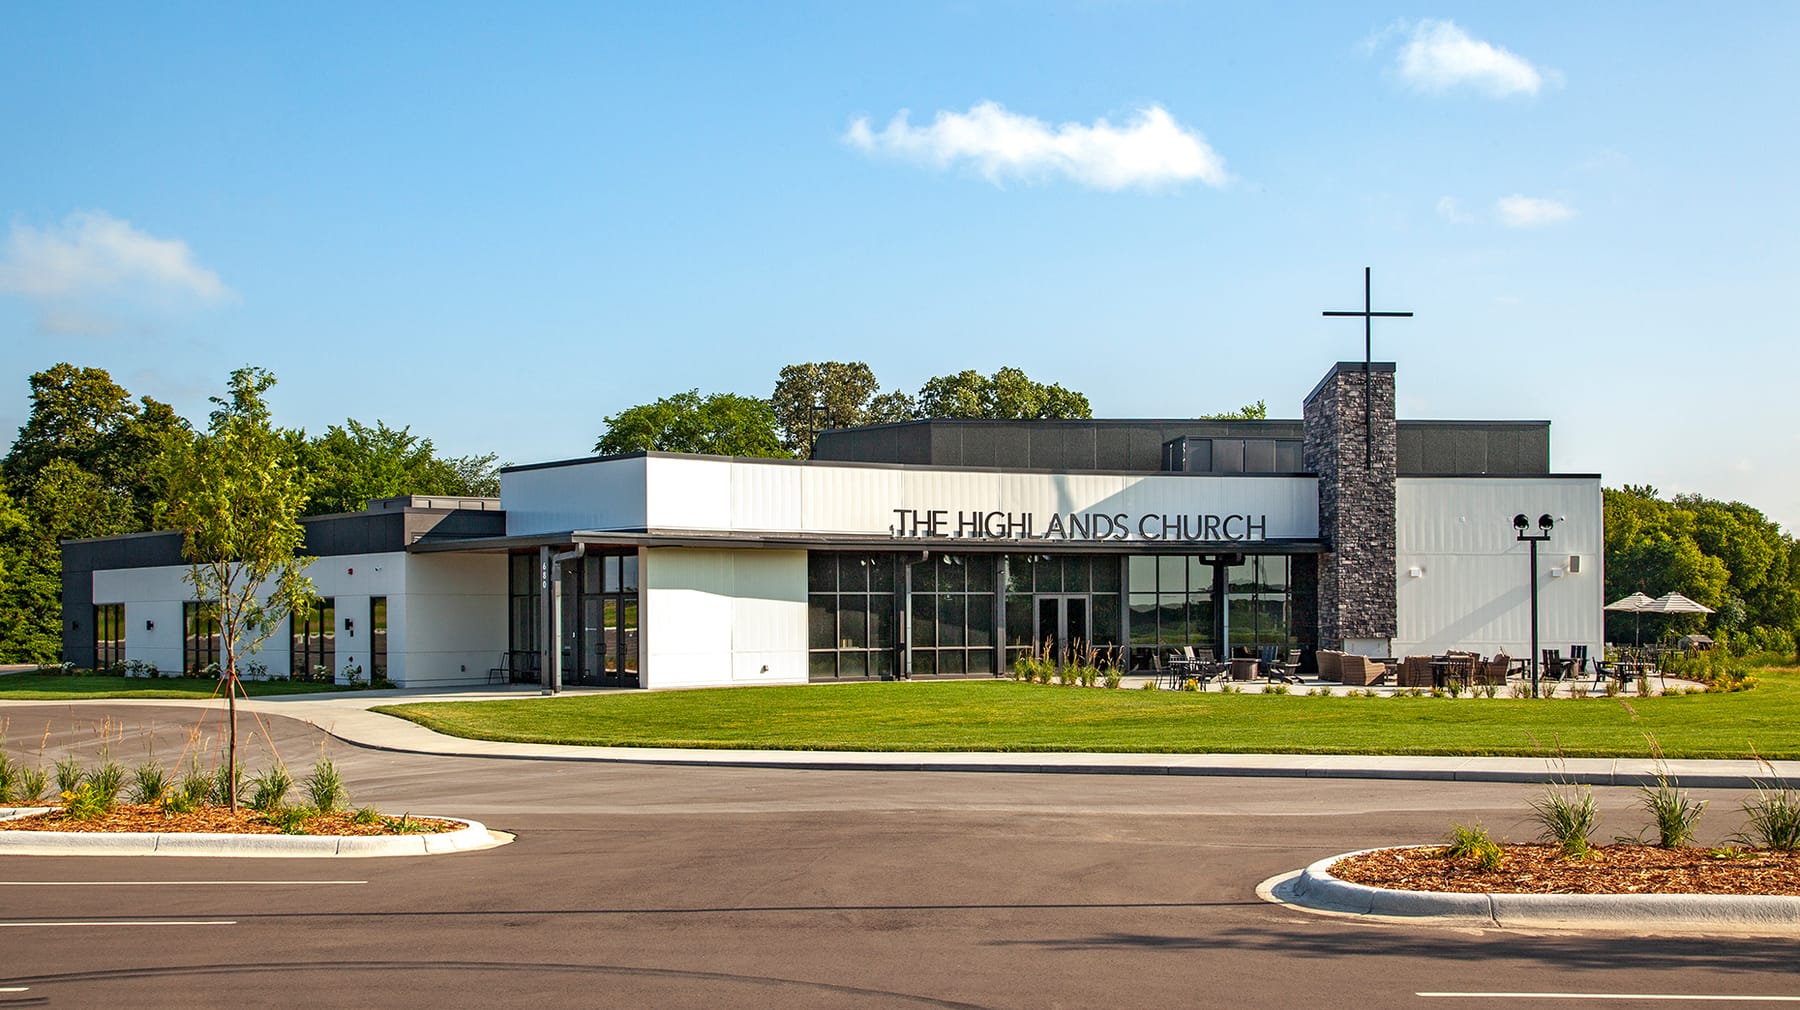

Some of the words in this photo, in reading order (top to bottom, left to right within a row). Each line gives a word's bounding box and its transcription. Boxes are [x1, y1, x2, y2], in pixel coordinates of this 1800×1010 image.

[893, 509, 949, 538] THE
[958, 511, 1129, 541] HIGHLANDS
[1138, 514, 1266, 541] CHURCH
